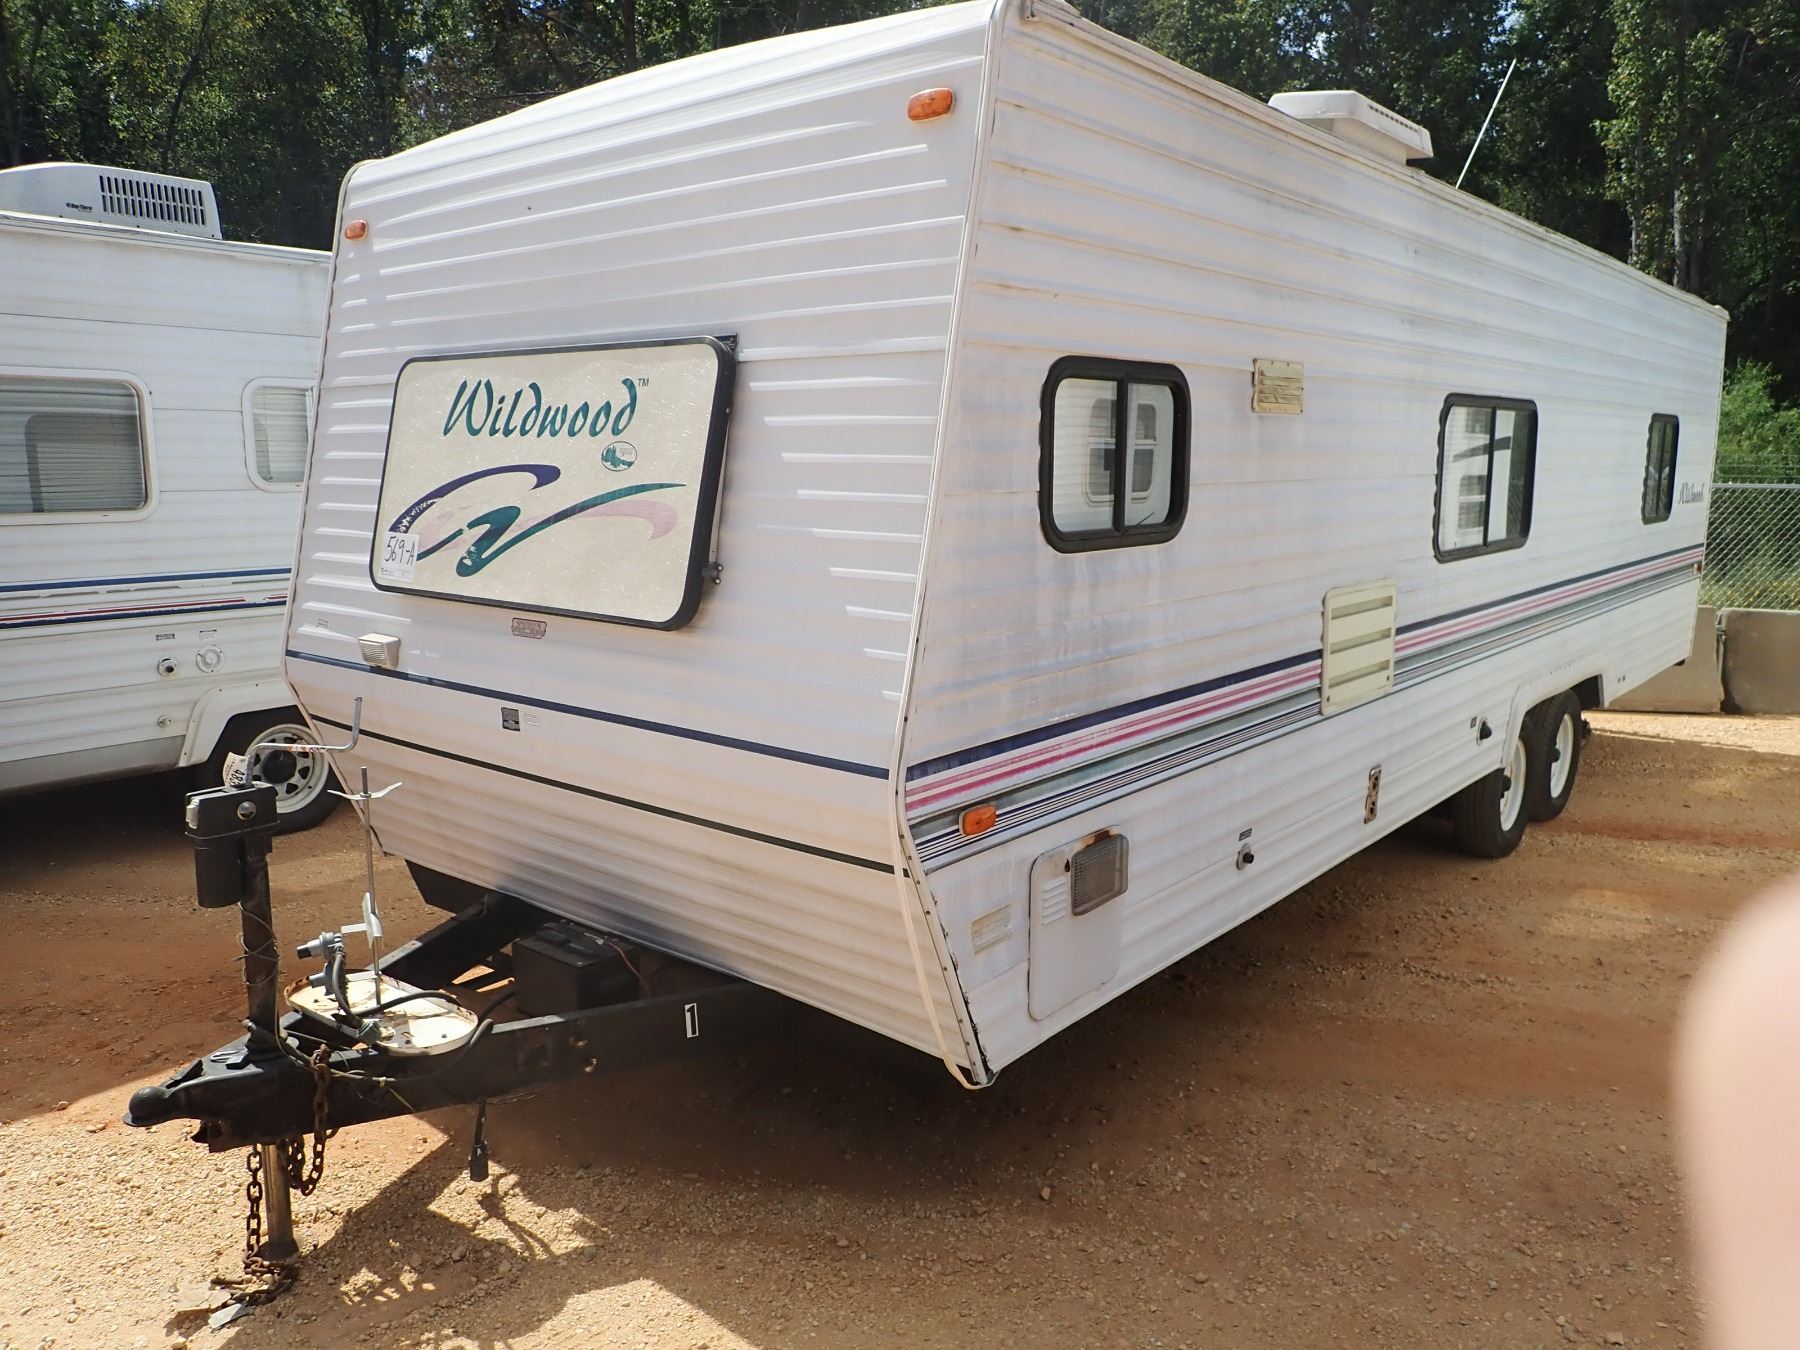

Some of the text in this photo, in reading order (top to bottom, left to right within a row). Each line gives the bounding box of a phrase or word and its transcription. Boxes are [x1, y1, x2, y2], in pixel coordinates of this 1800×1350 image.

[443, 377, 637, 438] Wildwood
[384, 536, 415, 566] 569-A
[686, 1004, 698, 1037] 1
